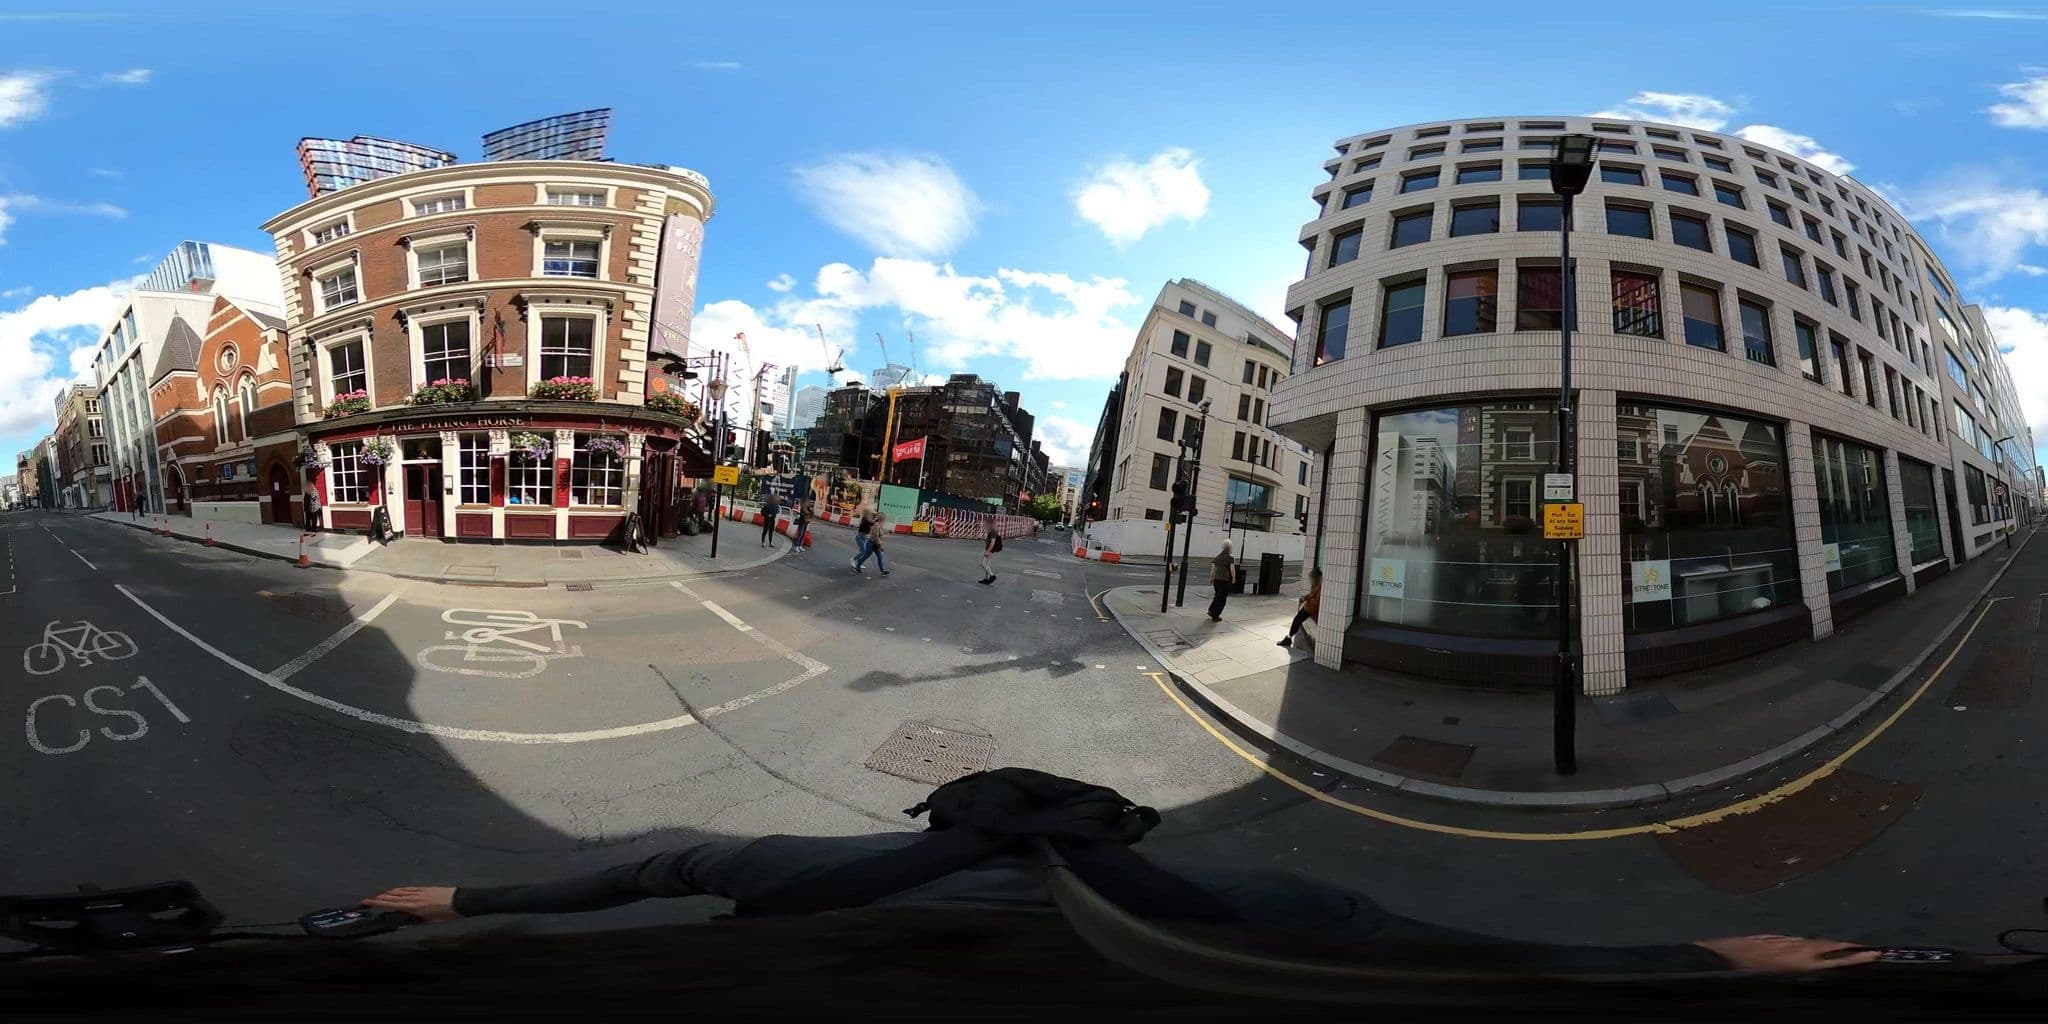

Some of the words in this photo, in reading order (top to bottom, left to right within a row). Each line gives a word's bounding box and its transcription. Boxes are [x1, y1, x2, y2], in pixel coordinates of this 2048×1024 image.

[392, 422, 415, 432] THE
[421, 418, 470, 429] FLYING
[478, 415, 524, 427] HORSE
[1371, 580, 1402, 589] STRETTONS
[1634, 583, 1670, 592] STRETTONS
[25, 675, 191, 754] CS1
